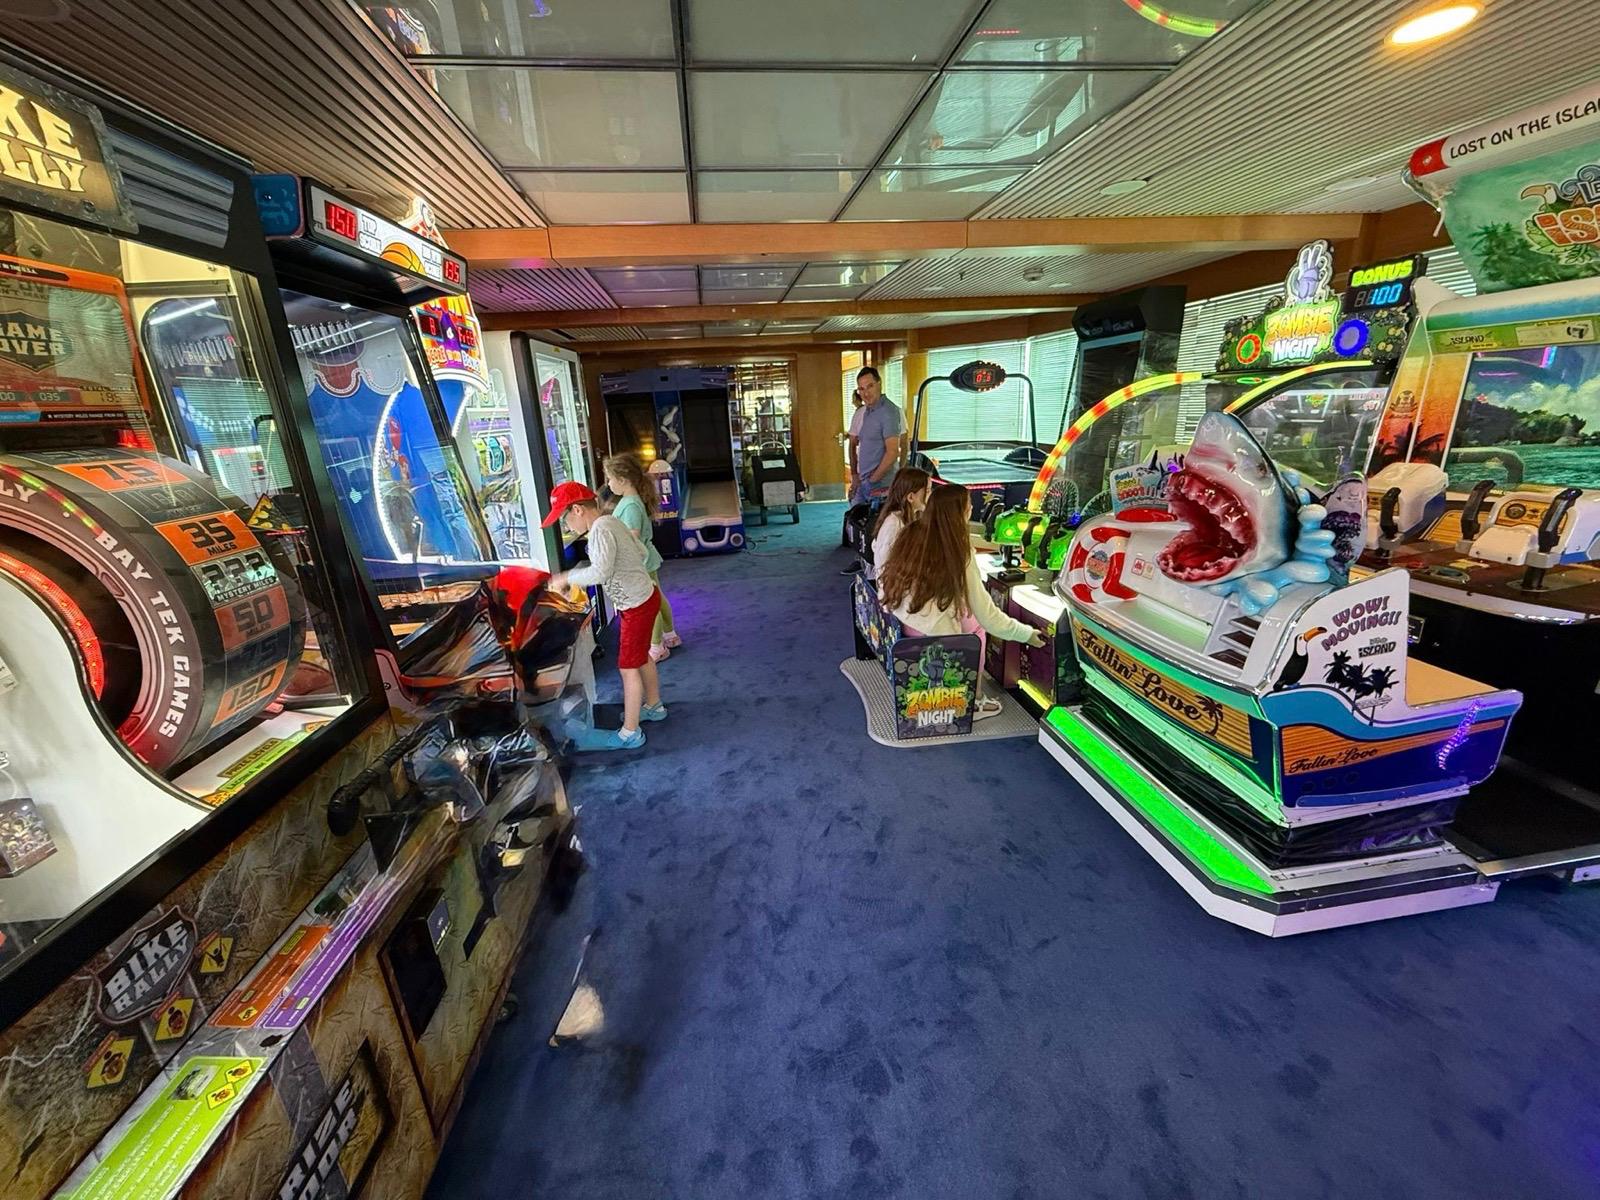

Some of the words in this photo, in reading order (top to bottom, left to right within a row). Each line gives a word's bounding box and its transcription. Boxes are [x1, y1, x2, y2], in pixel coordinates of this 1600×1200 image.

[1450, 136, 1487, 159] LOST
[1490, 128, 1513, 145] ON
[1517, 115, 1552, 136] THE
[1556, 97, 1600, 124] ISLA
[330, 205, 357, 239] 150
[445, 260, 460, 282] 135
[1351, 260, 1414, 287] BONUS
[1369, 282, 1403, 305] 100
[1266, 304, 1334, 342] ZOMBIE
[1273, 336, 1319, 361] NIGHT
[81, 462, 158, 481] 75
[178, 517, 236, 548] 35
[95, 531, 152, 581] BAY
[206, 543, 237, 556] MILES
[215, 585, 251, 602] MYSTERY
[252, 577, 275, 588] MILES
[150, 591, 185, 645] TEK
[234, 595, 274, 633] 50
[1332, 596, 1390, 627] WOW!
[1320, 610, 1402, 651] MOVING!!
[228, 668, 277, 711] 150
[1080, 628, 1138, 680] Fallin'
[1135, 668, 1202, 721] Love
[158, 655, 190, 738] GAMES
[906, 685, 968, 717] ZOMBIE
[917, 708, 956, 727] NIGHT
[1289, 752, 1341, 774] Fallin'
[1339, 748, 1379, 766] Love
[105, 919, 188, 1000] BIKE
[113, 938, 188, 1014] RALLY
